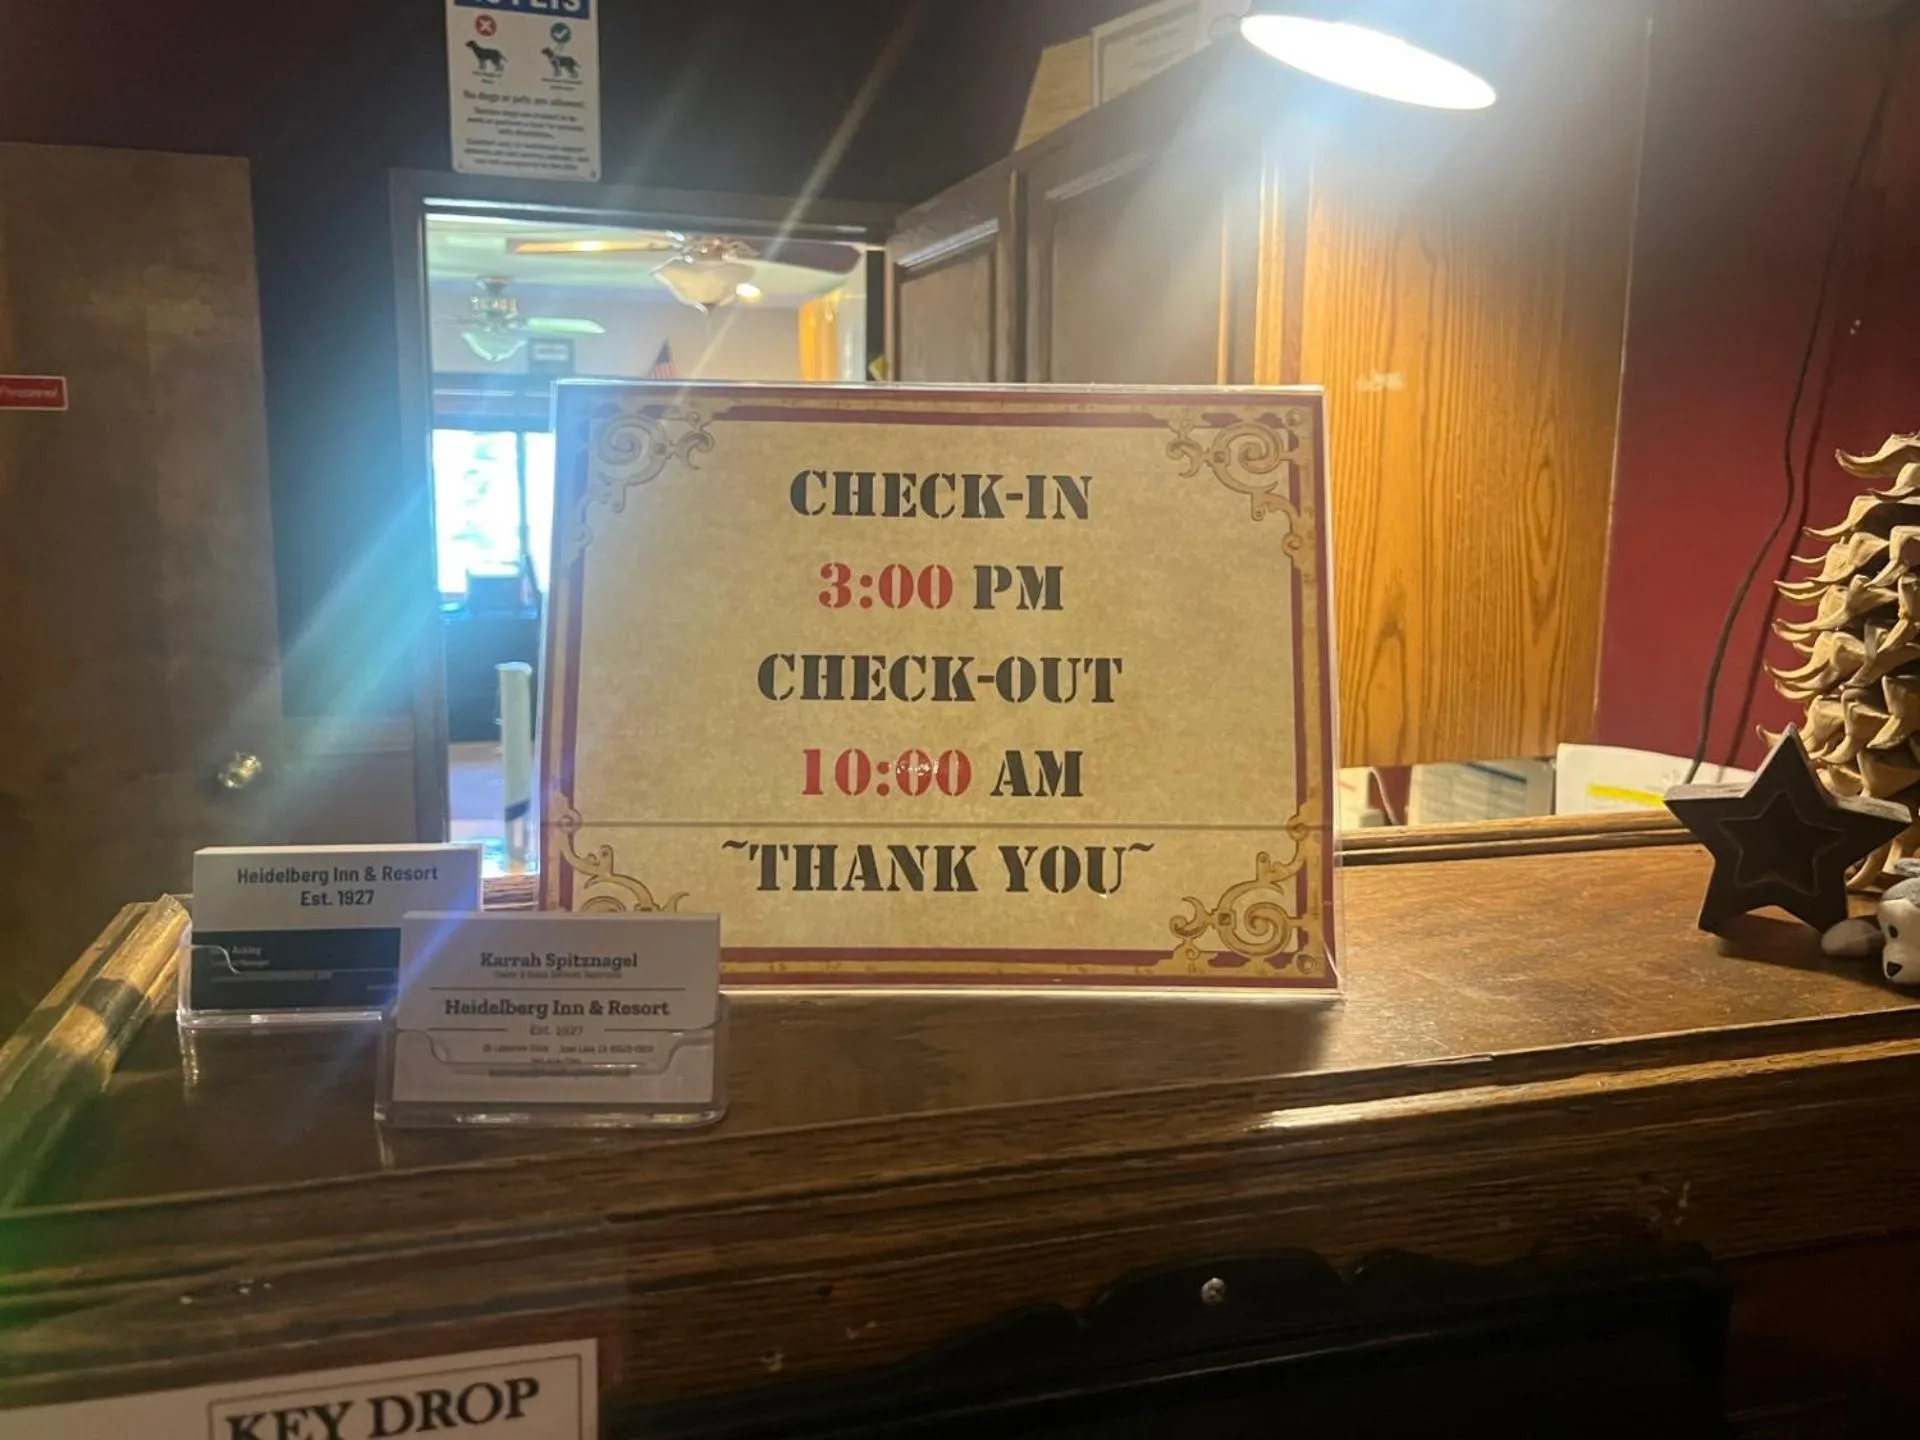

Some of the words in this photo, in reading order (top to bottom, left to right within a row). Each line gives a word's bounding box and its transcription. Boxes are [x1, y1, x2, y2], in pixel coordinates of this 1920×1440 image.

[790, 469, 1093, 520] CHECK-IN
[819, 562, 953, 610] 3:00
[973, 565, 1064, 611] PM
[757, 653, 1122, 704] CHECK-OUT
[802, 748, 972, 797] 10:00
[990, 750, 1083, 797] AM
[237, 867, 329, 886] Heidelberg
[333, 867, 359, 883] Inn
[364, 866, 377, 882] &
[382, 866, 438, 881] Resort
[301, 891, 333, 906] Est.
[337, 890, 374, 905] 1927
[480, 952, 542, 968] Karrah
[545, 952, 638, 971] Spitznagel
[445, 999, 548, 1019] Heidelberg
[552, 1000, 584, 1015] Inn
[589, 1000, 604, 1015] &
[608, 1000, 669, 1015] Resort
[367, 1377, 539, 1439] DROP
